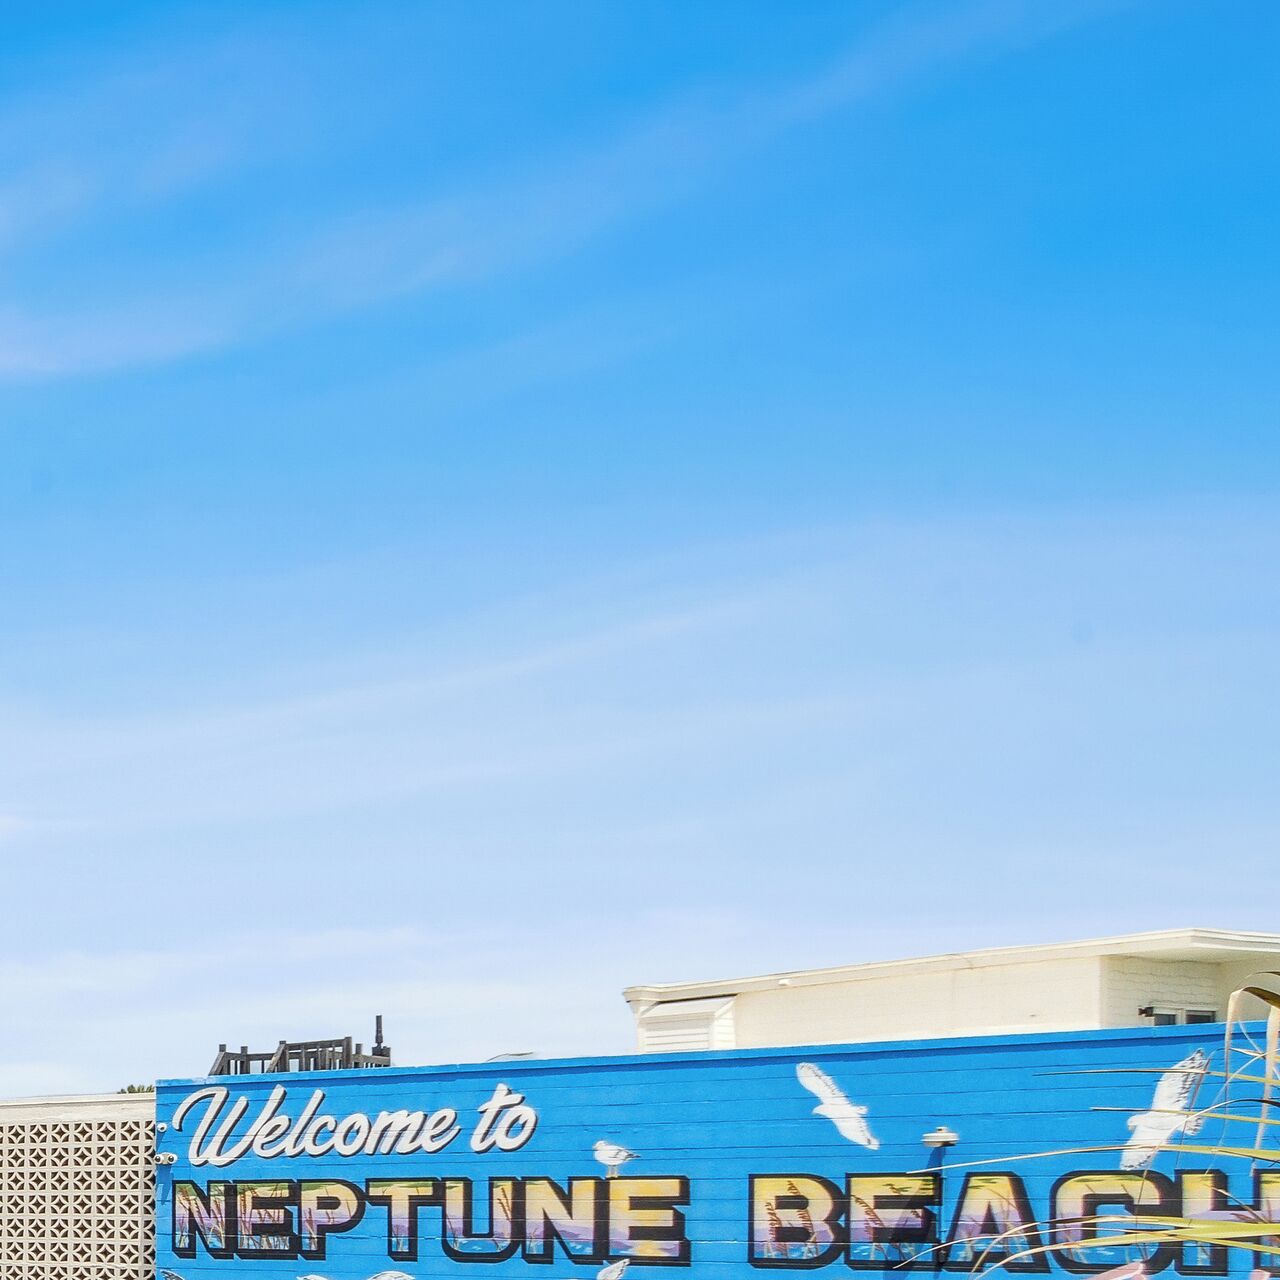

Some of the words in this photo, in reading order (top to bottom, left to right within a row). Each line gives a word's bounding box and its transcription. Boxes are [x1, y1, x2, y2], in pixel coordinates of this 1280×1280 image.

[171, 1083, 461, 1168] Welcome
[469, 1082, 539, 1154] to
[171, 1174, 691, 1267] NEPTUNE
[747, 1168, 1280, 1277] BEACH
